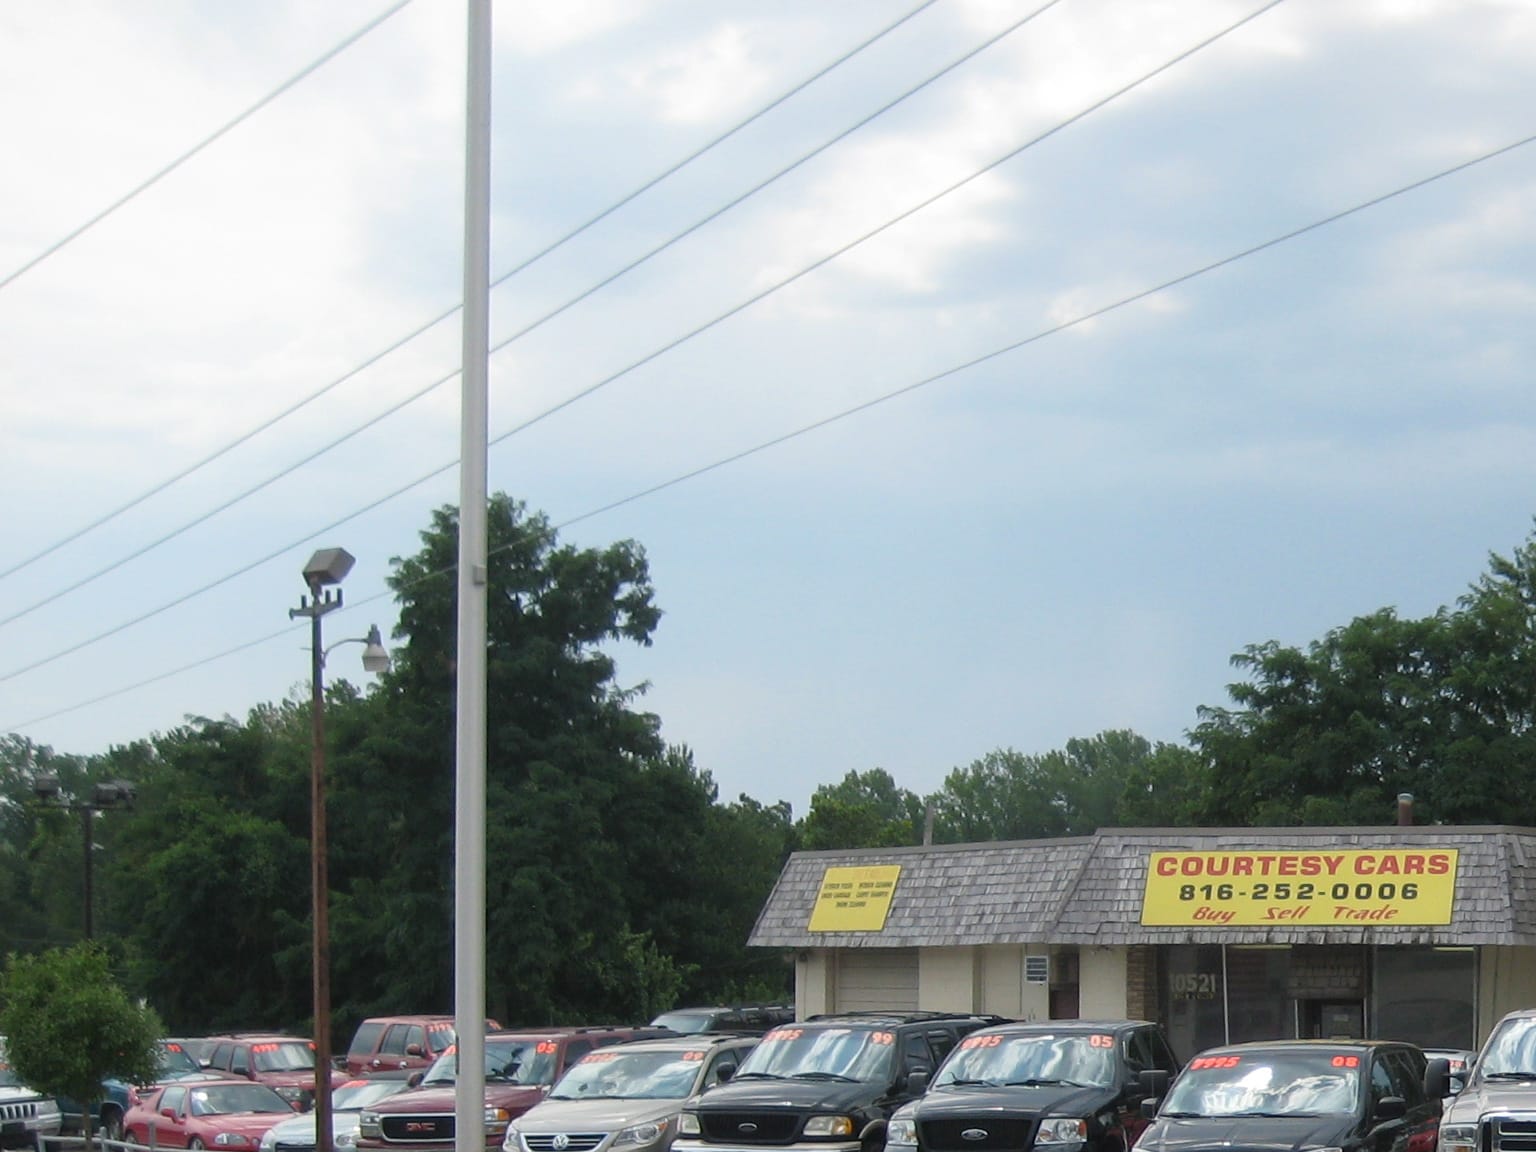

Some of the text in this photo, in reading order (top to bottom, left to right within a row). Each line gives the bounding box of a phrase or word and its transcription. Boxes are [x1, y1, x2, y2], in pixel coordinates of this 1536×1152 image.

[1156, 855, 1449, 876] COURTESY CARS
[1179, 883, 1418, 900] 816-252-0006
[1192, 904, 1398, 923] Buy Sell Trade
[1169, 973, 1216, 992] 10521
[872, 1032, 893, 1045] 99
[1090, 1035, 1114, 1048] 05
[536, 1042, 557, 1054] 05
[1332, 1056, 1359, 1067] 08
